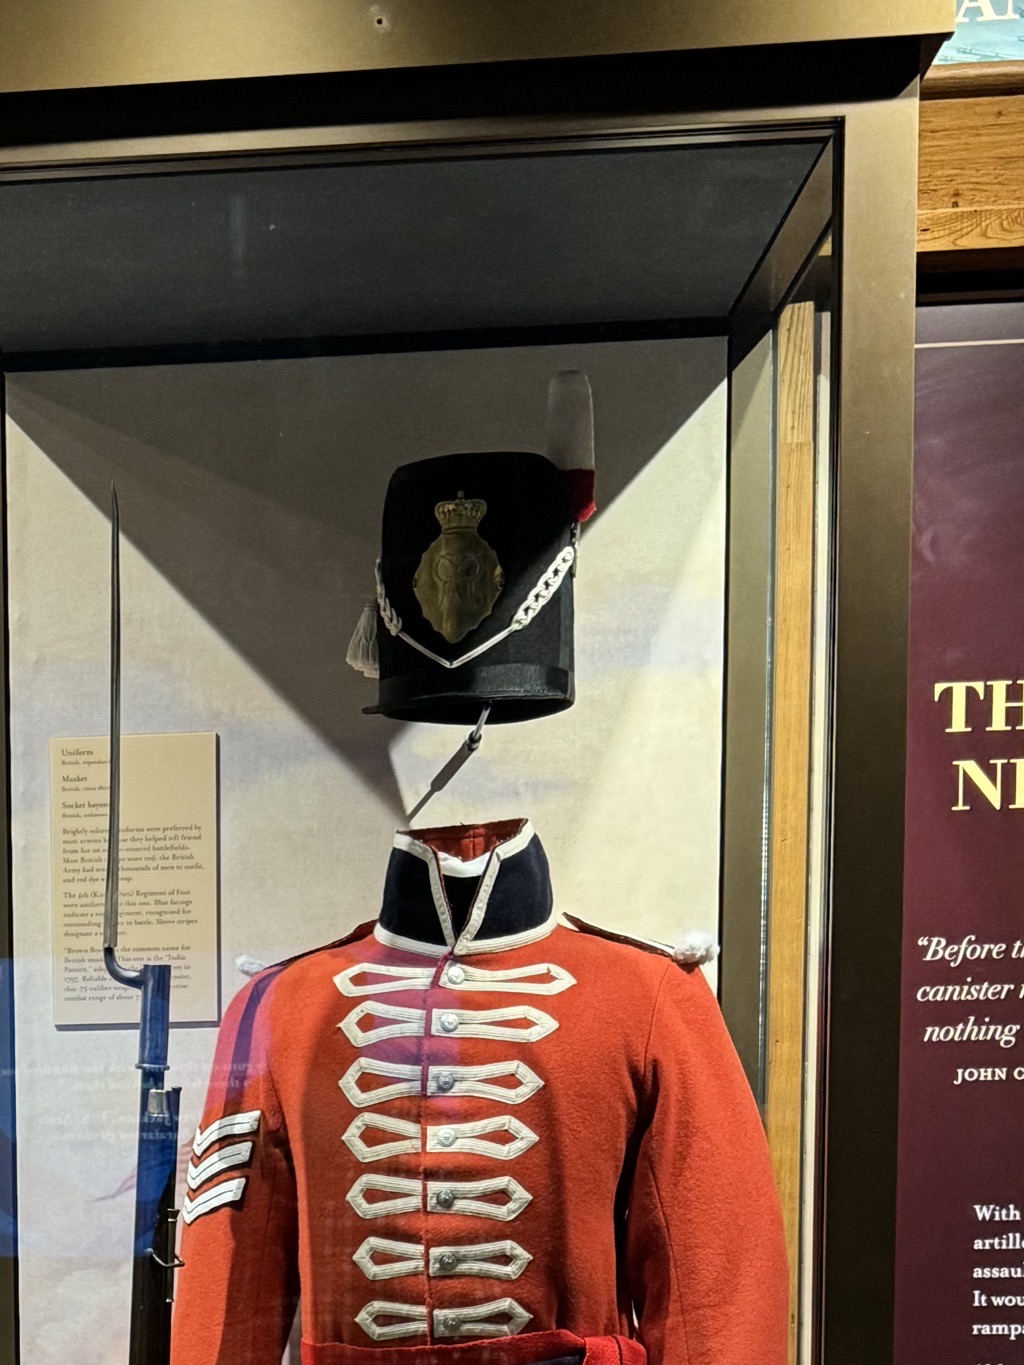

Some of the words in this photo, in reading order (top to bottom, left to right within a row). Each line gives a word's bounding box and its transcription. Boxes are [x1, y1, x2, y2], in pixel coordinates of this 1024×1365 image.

[916, 976, 1014, 1002] canister
[923, 1016, 1021, 1048] nothing
[953, 1067, 1007, 1085] JOHN
[973, 1204, 1021, 1221] With
[973, 1261, 1024, 1279] assau
[973, 1290, 988, 1307] It
[972, 1323, 1024, 1341] ramp
